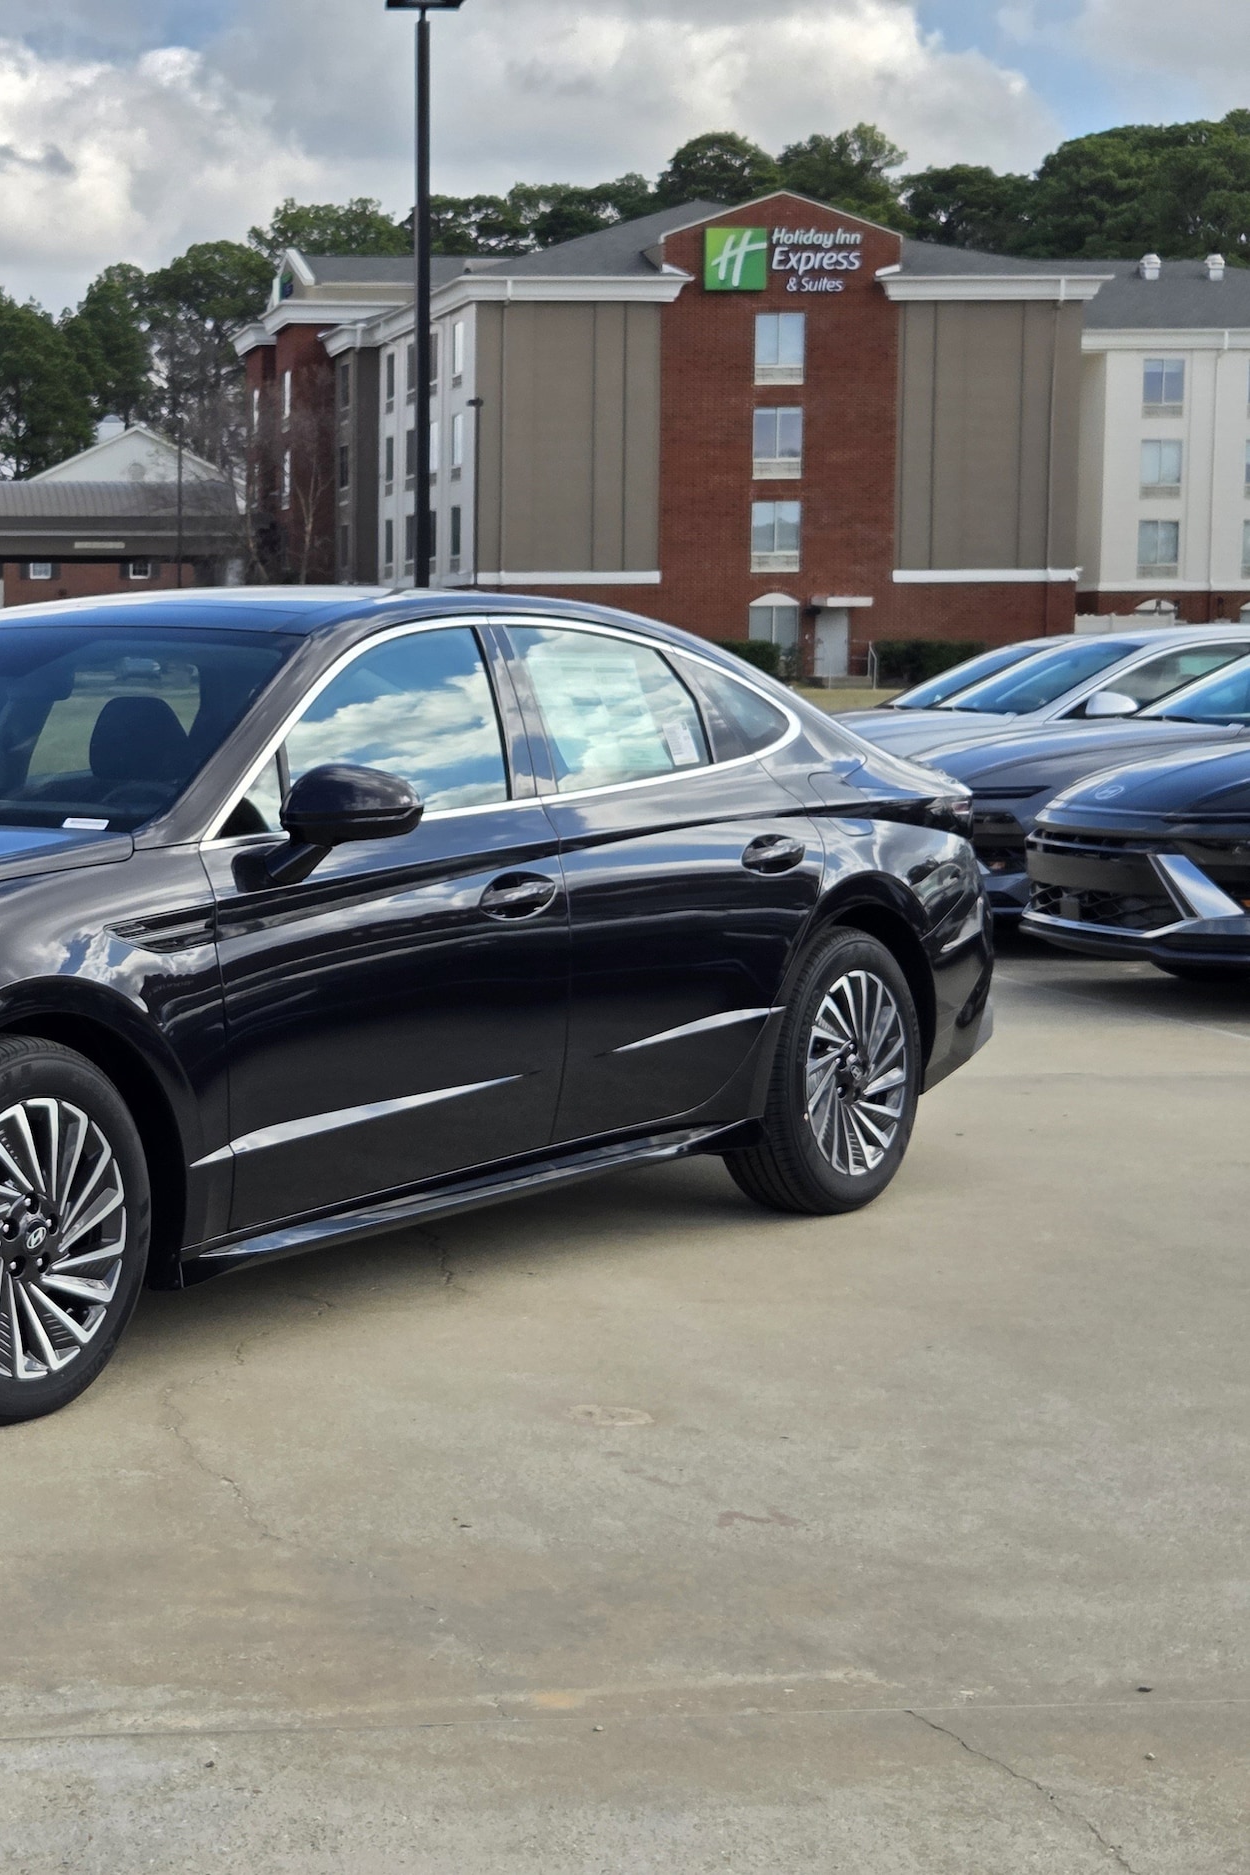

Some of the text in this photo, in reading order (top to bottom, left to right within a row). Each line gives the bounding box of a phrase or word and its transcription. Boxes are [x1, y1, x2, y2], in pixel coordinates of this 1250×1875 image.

[772, 227, 862, 248] Holiday Inn
[771, 246, 861, 276] Express
[786, 276, 844, 292] & Suites
